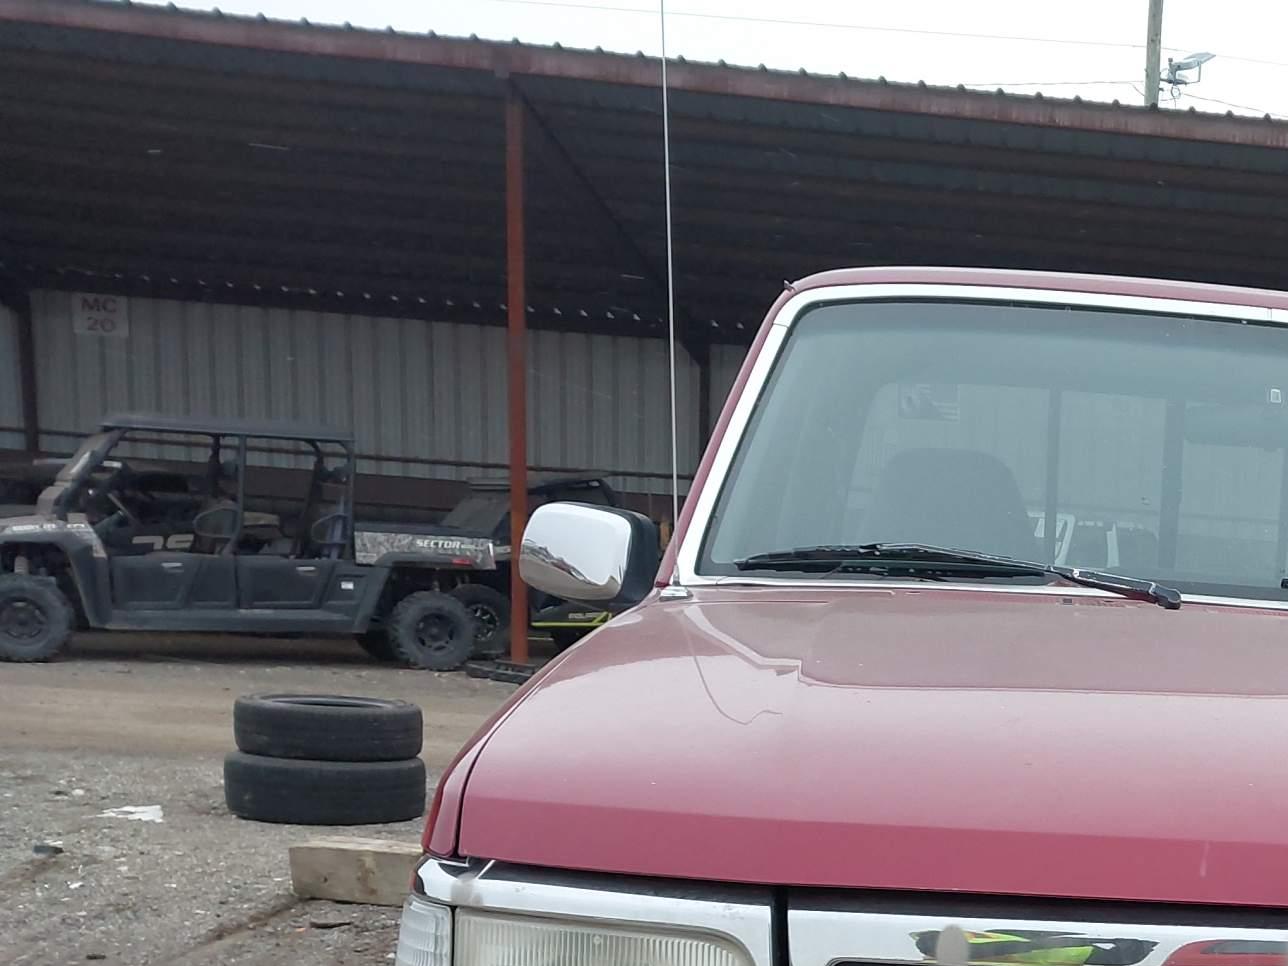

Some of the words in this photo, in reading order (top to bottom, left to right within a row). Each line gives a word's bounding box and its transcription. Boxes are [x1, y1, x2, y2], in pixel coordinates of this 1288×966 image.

[81, 296, 117, 313] MC
[87, 317, 117, 333] 20
[416, 539, 460, 550] SECTOR
